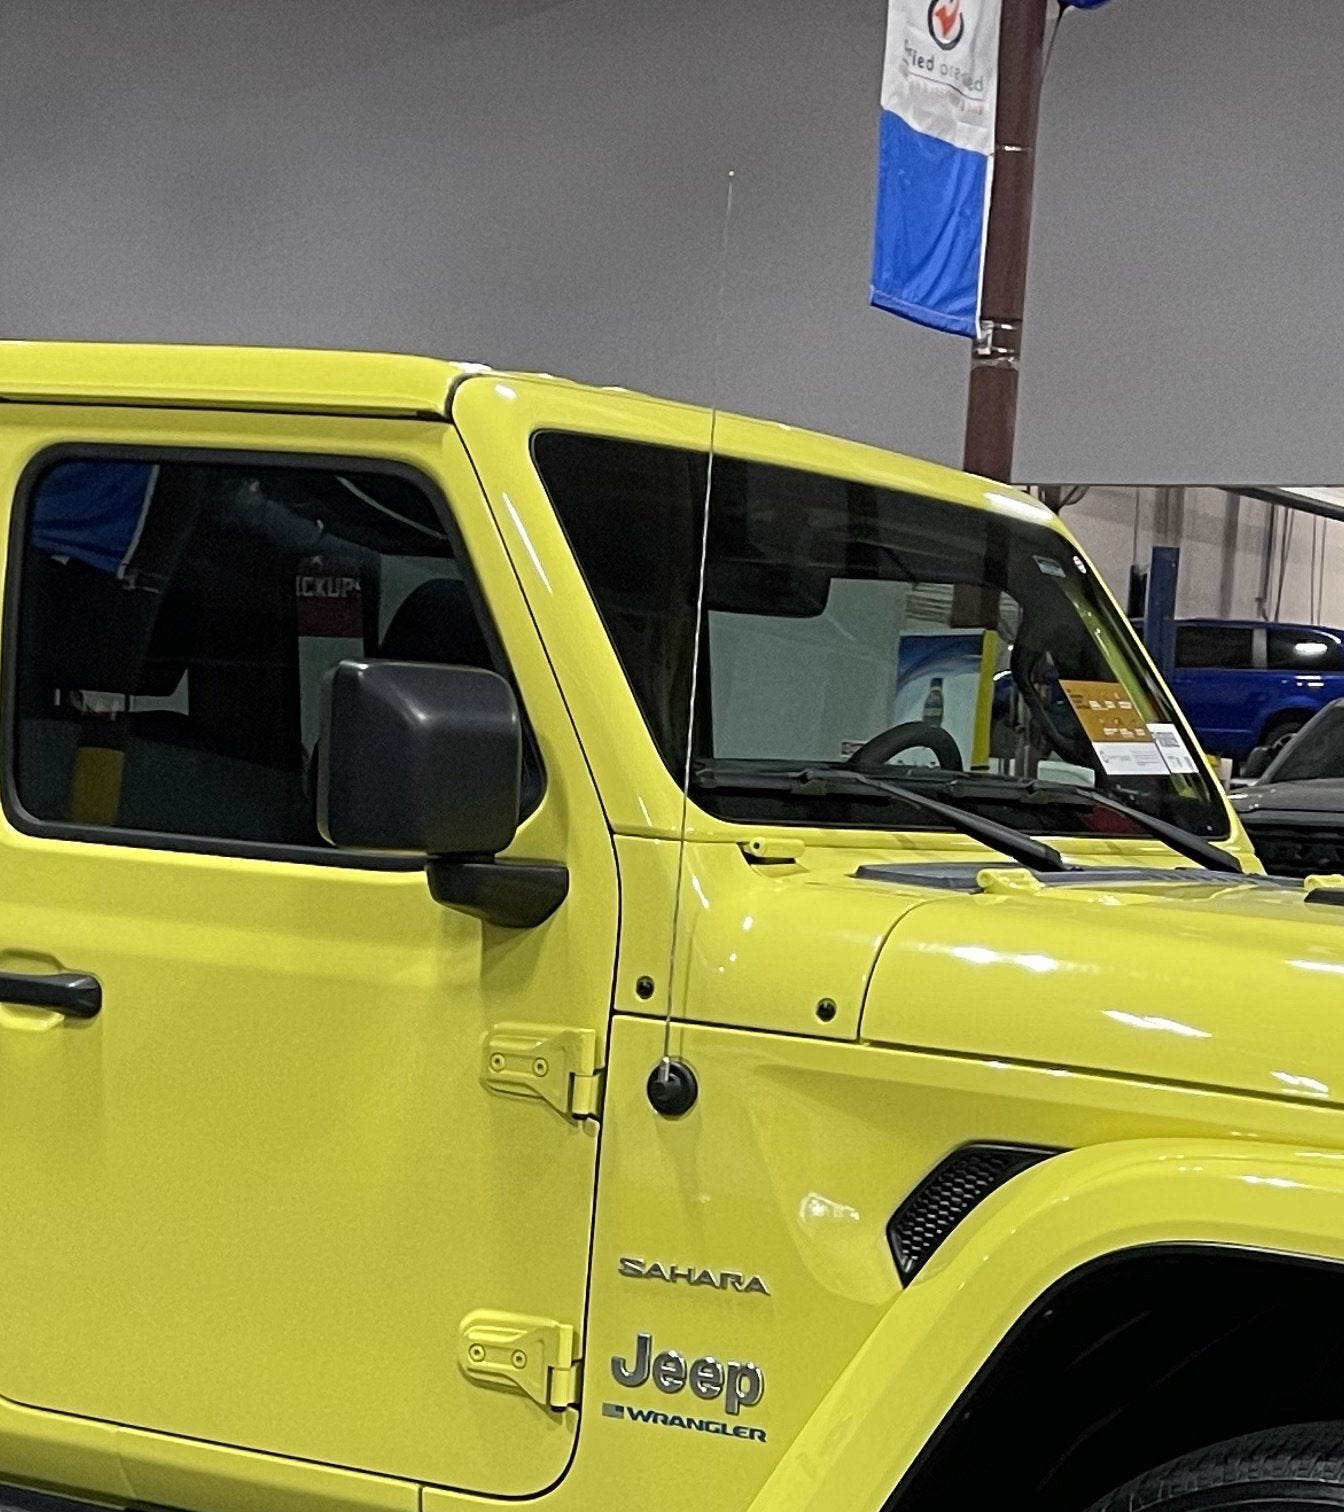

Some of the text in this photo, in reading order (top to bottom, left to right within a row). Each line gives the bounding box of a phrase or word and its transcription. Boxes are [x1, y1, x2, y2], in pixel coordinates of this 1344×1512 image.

[618, 1256, 771, 1296] SAHARA
[611, 1332, 765, 1416] Jeep
[626, 1406, 768, 1443] WRANGLER
